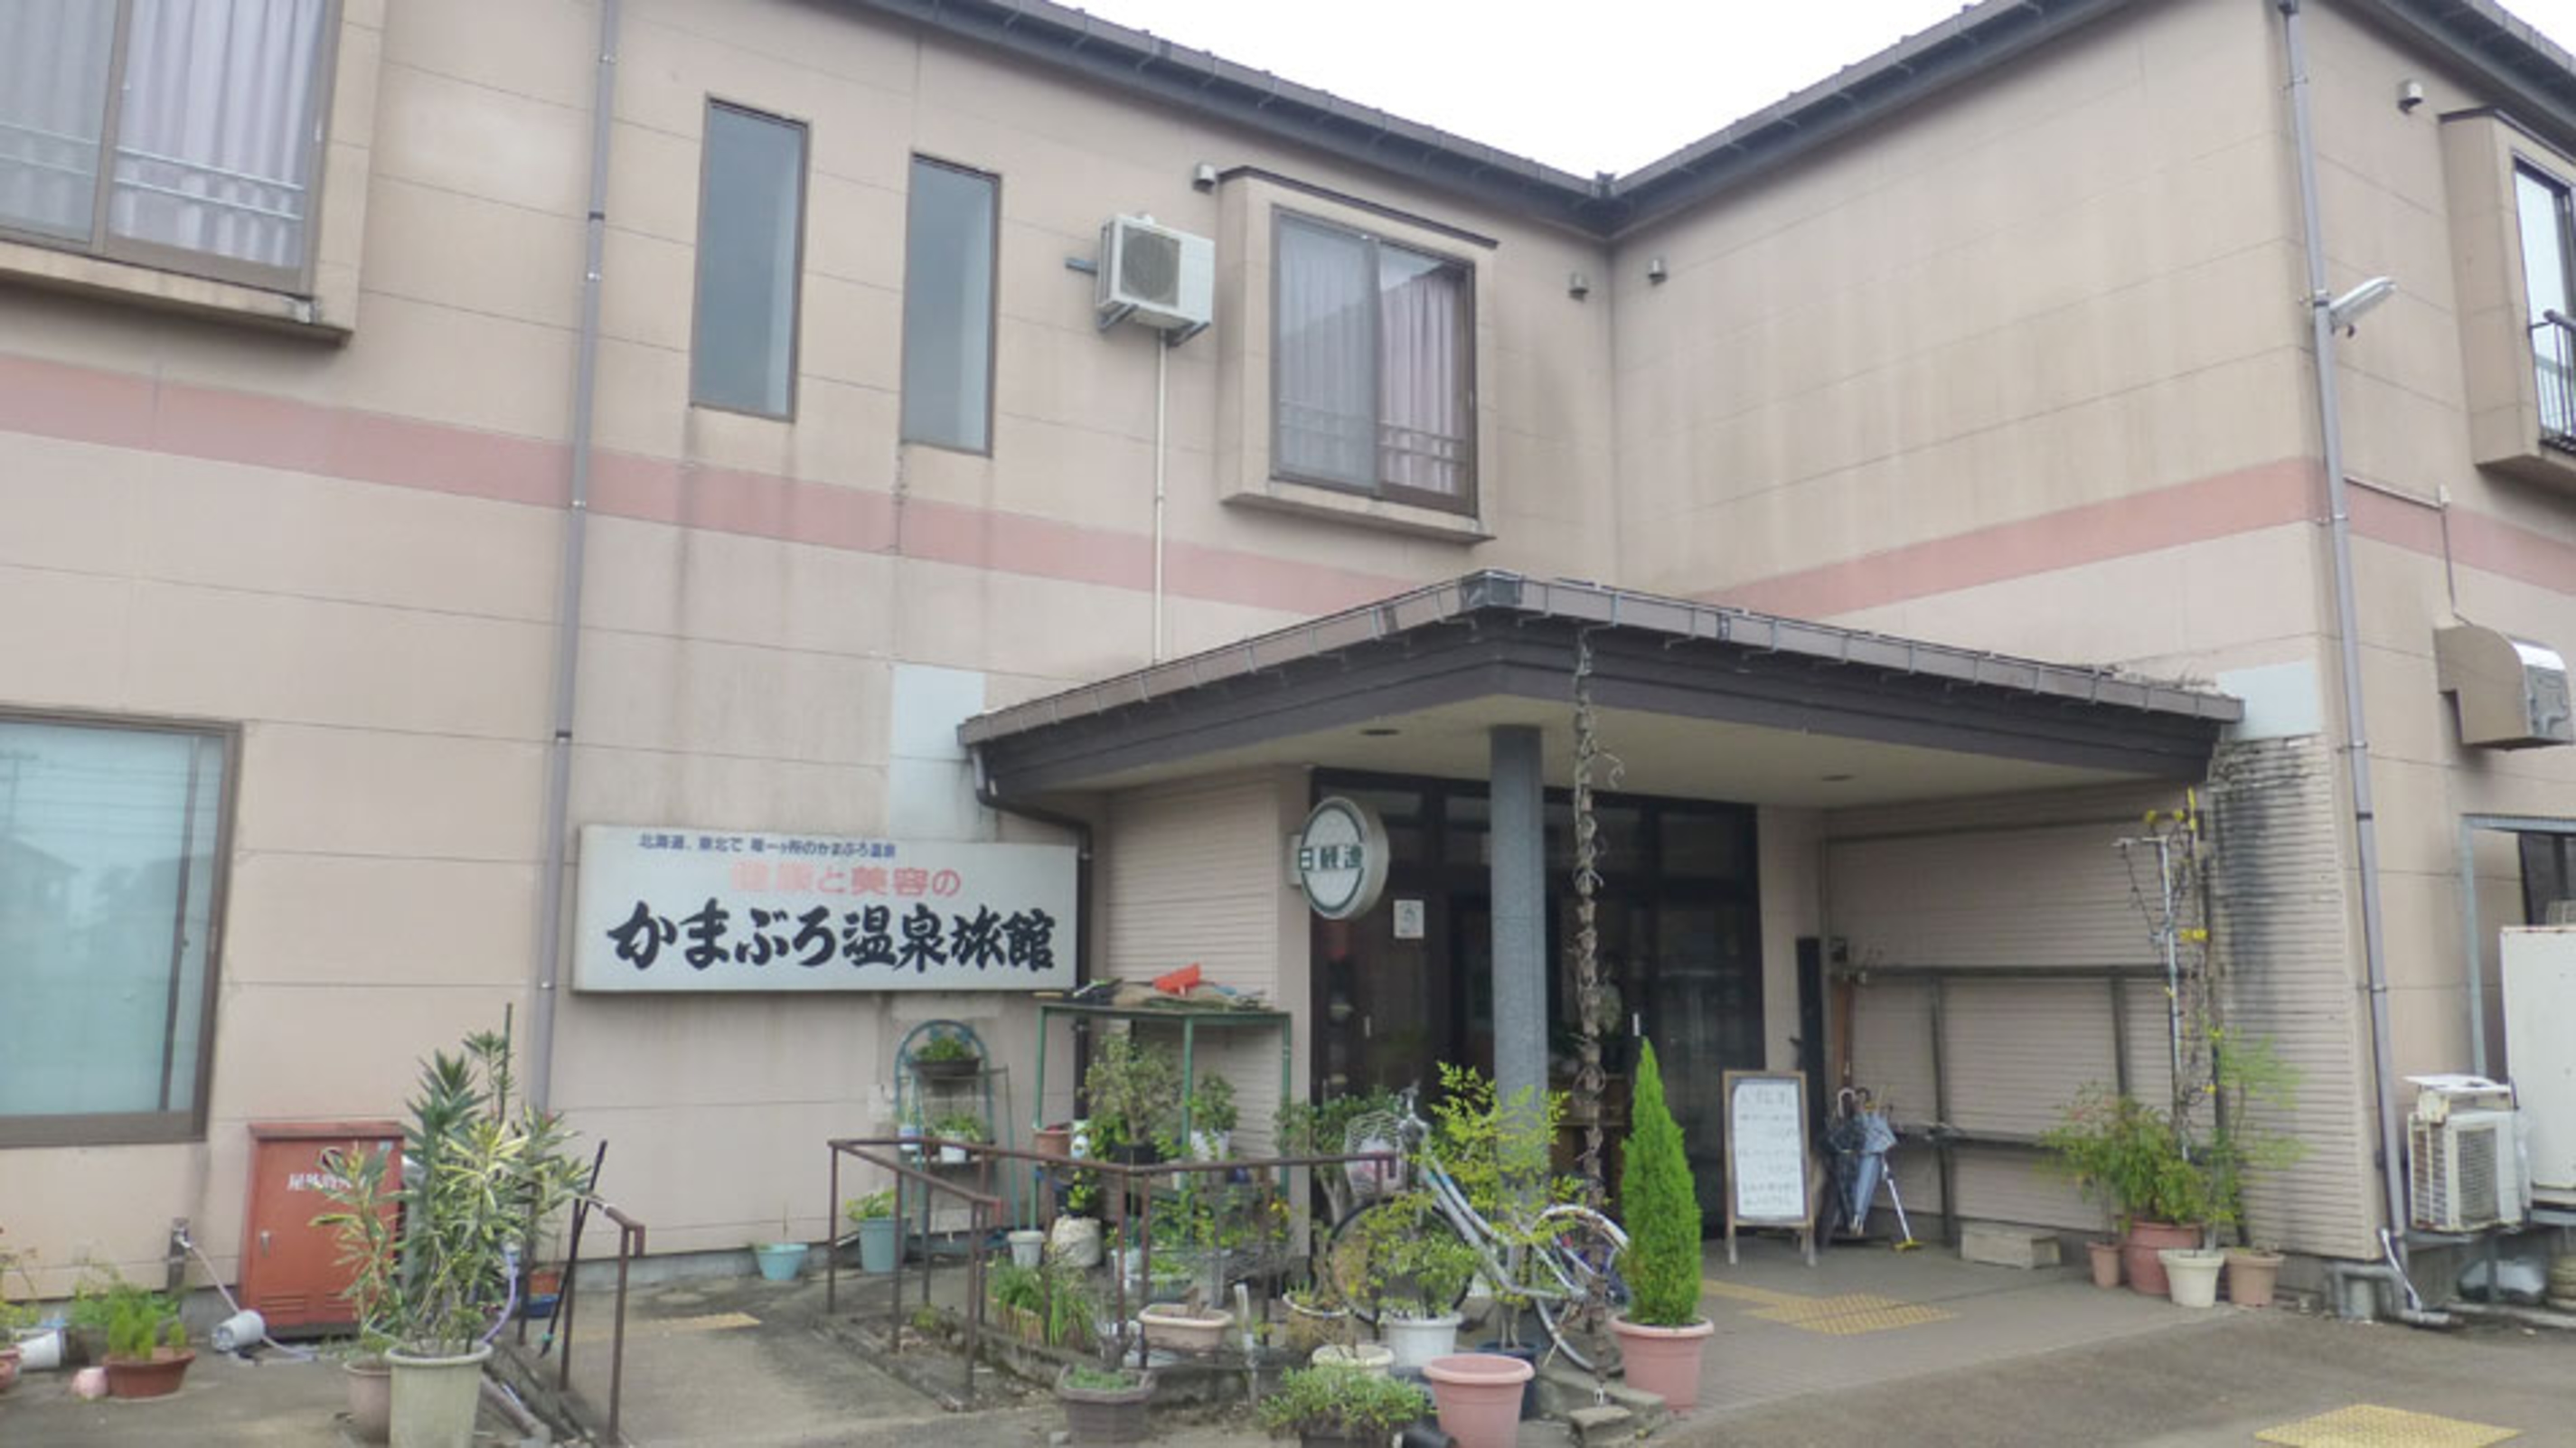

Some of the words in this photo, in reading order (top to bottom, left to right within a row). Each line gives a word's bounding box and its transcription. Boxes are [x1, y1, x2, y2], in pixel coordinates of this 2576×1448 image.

[606, 898, 1056, 973] かまぶろ温泉旅館
